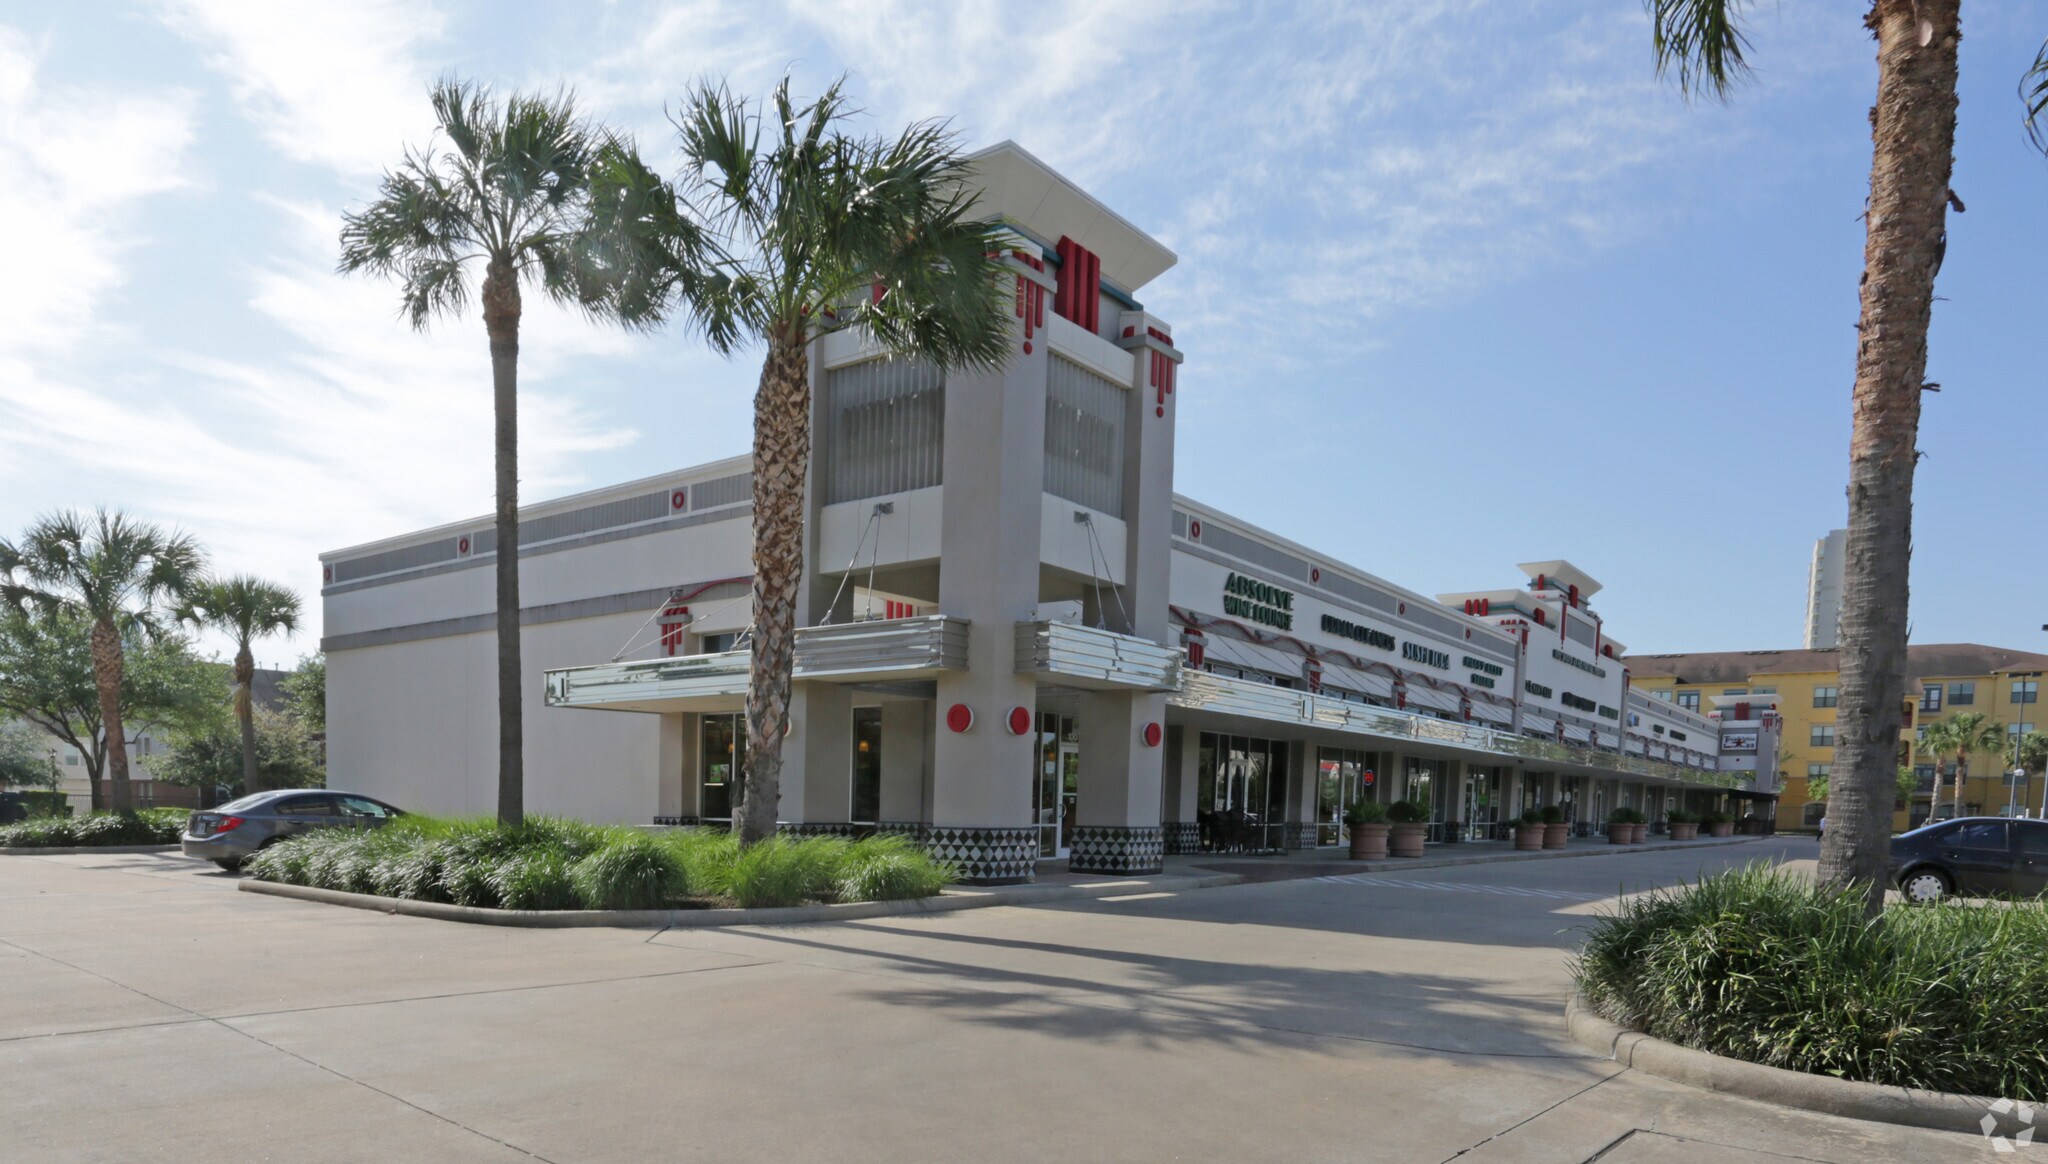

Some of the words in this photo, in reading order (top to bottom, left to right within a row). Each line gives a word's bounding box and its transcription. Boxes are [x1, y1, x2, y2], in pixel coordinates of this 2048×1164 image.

[1224, 572, 1294, 611] ABSOLVE
[1224, 594, 1253, 619] WINE
[1252, 604, 1293, 631] LOUNGE
